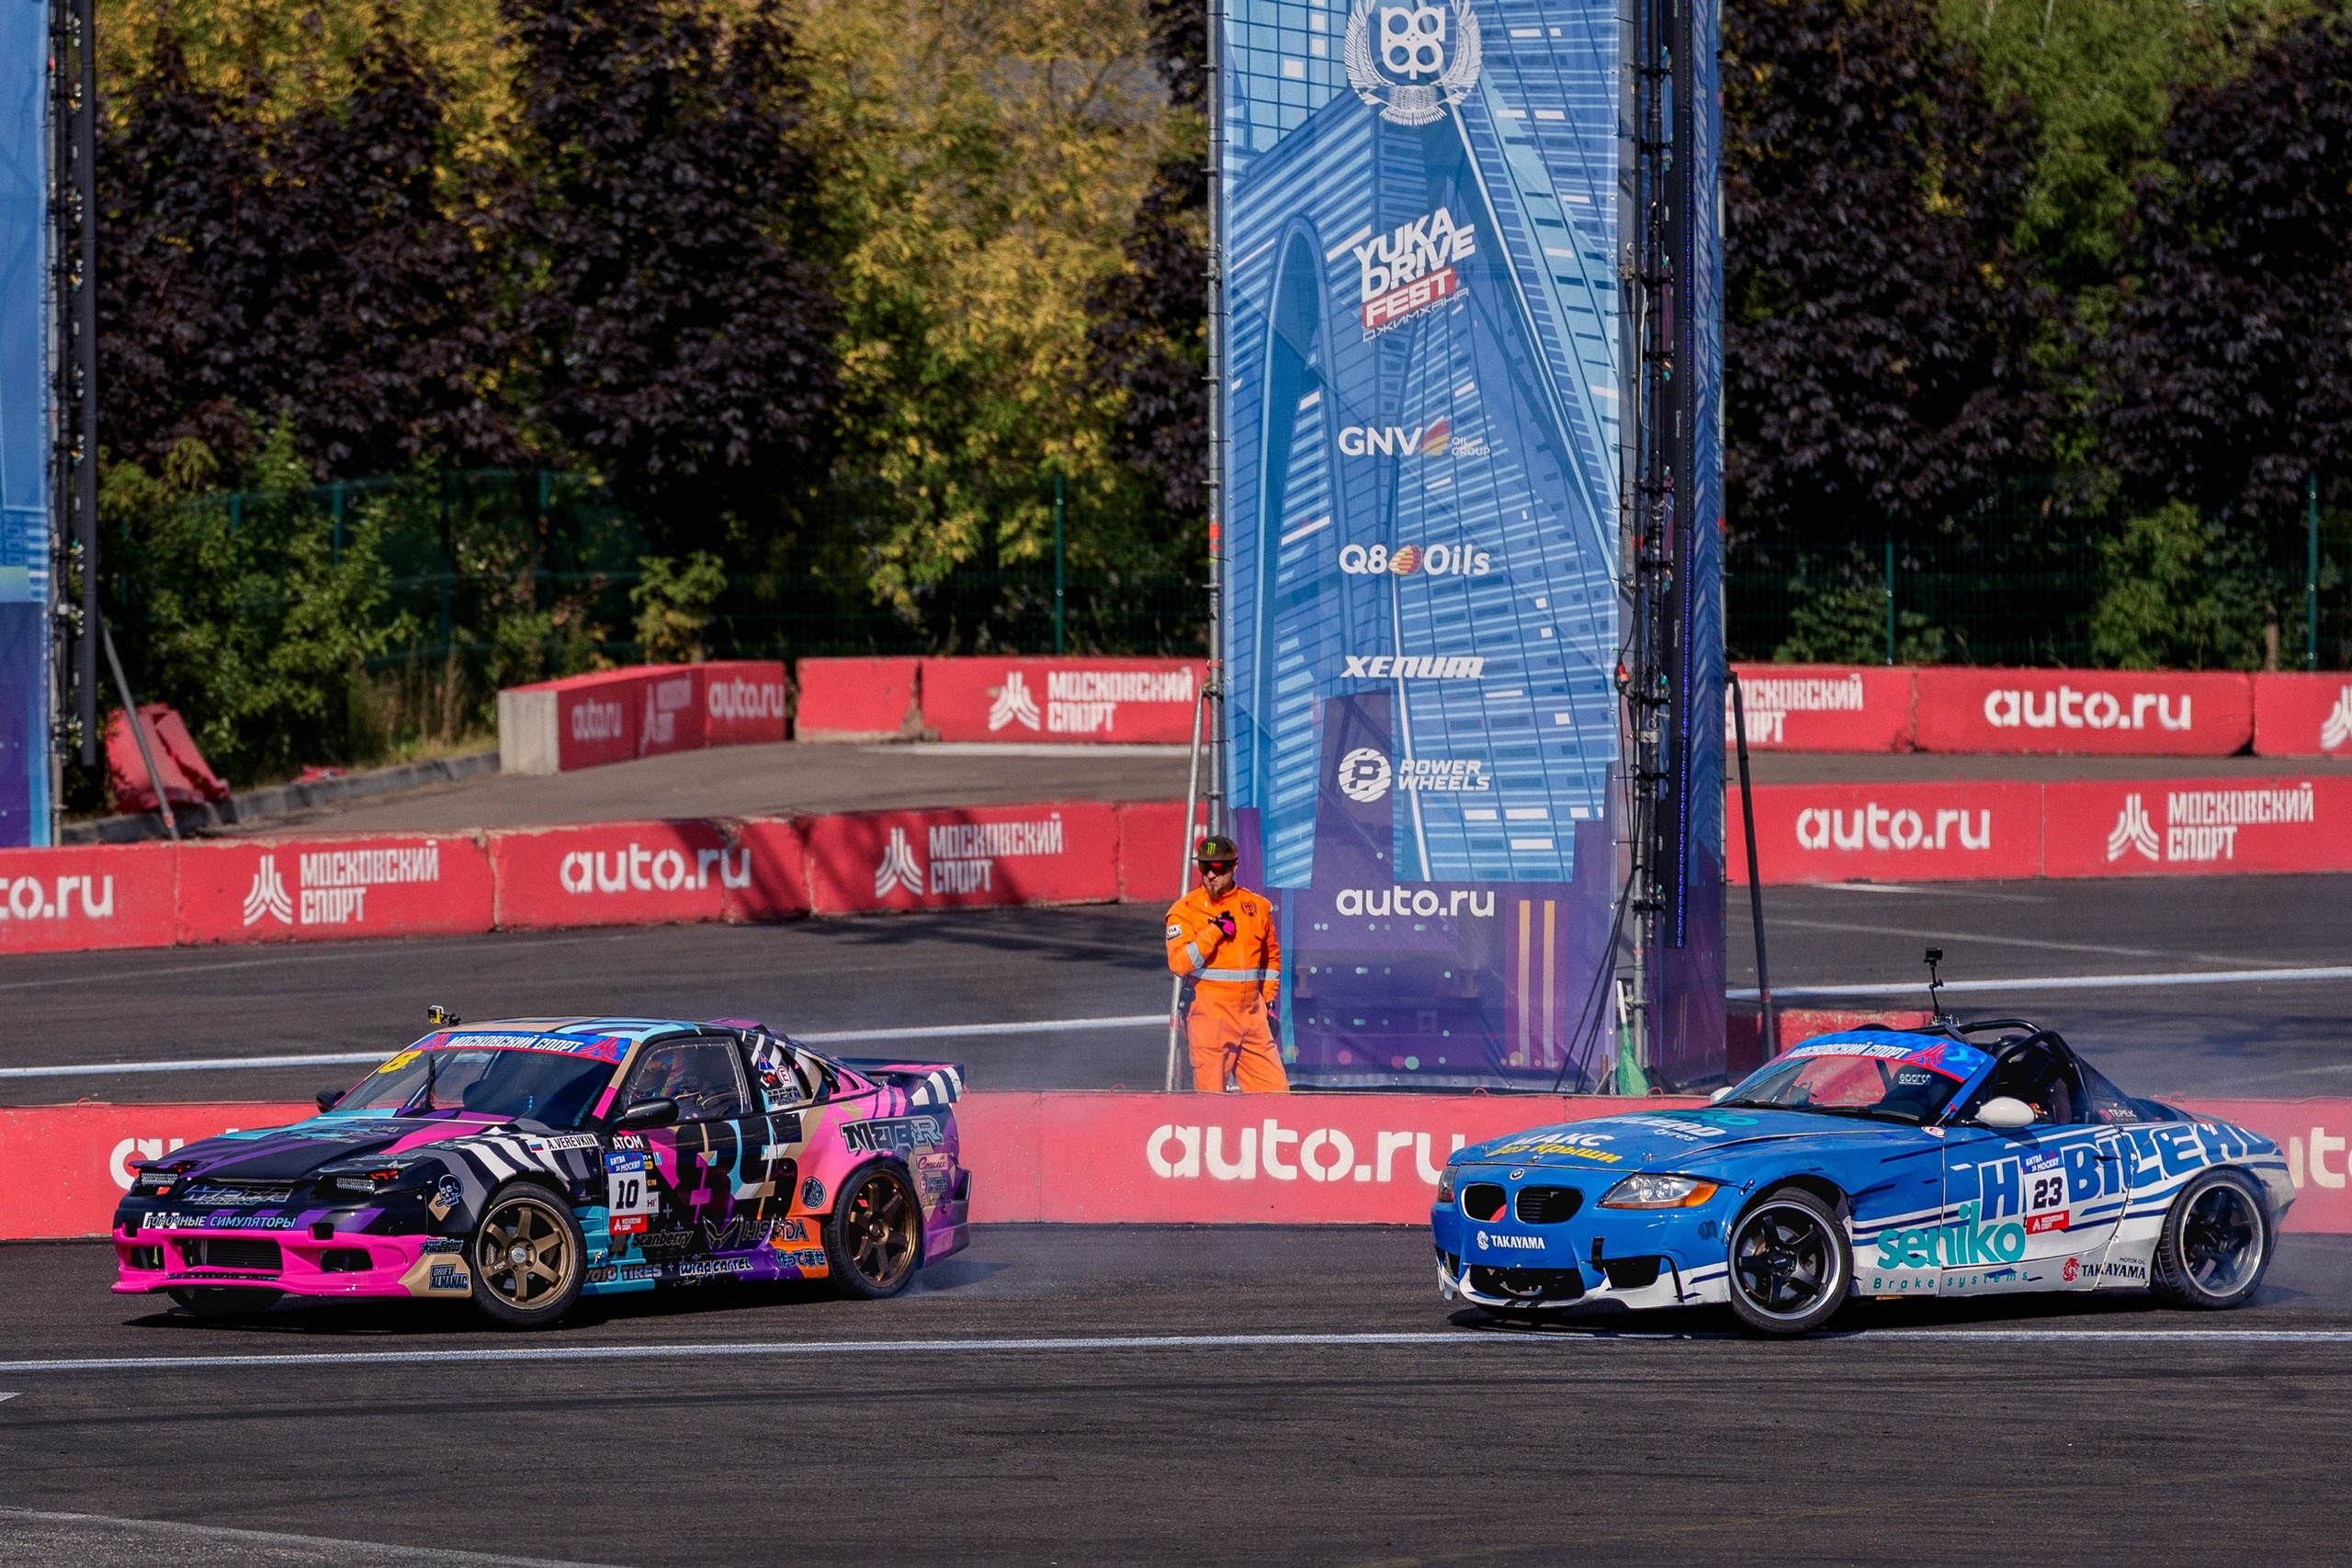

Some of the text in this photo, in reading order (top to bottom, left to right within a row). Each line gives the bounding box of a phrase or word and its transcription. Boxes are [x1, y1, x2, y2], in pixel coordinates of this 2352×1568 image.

[1352, 207, 1456, 272] YUKA
[1362, 224, 1476, 303] DRIVE
[1365, 267, 1453, 328] FEST
[1338, 426, 1423, 457] GNV
[1452, 446, 1490, 457] GROUP
[1339, 544, 1490, 576] Q8 Oils
[1047, 666, 1193, 703] МОСКОВСКИЙ
[1047, 701, 1117, 734] СПОРТ
[1984, 684, 2192, 730] auto.ru
[1397, 775, 1490, 791] WHEELS
[1399, 760, 1482, 775] POWER
[2167, 783, 2313, 826] МОСКОВСКИЙ
[930, 813, 1063, 859] МОСКОВСКИЙ
[1795, 803, 1991, 850] auto.ru
[2167, 825, 2238, 861] СПОРТ
[300, 840, 440, 887] МОСКОВСКИЙ
[560, 842, 751, 895] auto.ru
[930, 858, 994, 895] СПОРТ
[300, 886, 367, 925] СПОРТ
[1336, 886, 1495, 917] auto.ru
[446, 1035, 584, 1053] МОСКОВСКИЙ СПОРТ
[1863, 1046, 1913, 1059] СПОРТ
[547, 1134, 596, 1150] A.VEREVKIN
[612, 1134, 643, 1150] ATOM
[1147, 1119, 1465, 1185] auto.ru
[1530, 1143, 1623, 1163] Крыши
[2025, 1154, 2042, 1167] БИТВА
[2037, 1157, 2060, 1172] МОСКВУ
[615, 1179, 640, 1210] 10
[2032, 1176, 2064, 1210] 23
[145, 1214, 297, 1228] ГОНОЧНЫЕ СИМУЛЯТОРЫ
[1877, 1200, 2026, 1269] seniko
[1490, 1235, 1545, 1249] TAKAYAMA
[430, 1275, 469, 1290] ALMANAC
[434, 1268, 453, 1276] DRIFT
[622, 1263, 662, 1280] TIRES
[1873, 1270, 2029, 1290] Brake systems
[2082, 1262, 2146, 1279] TAKAYAMA
